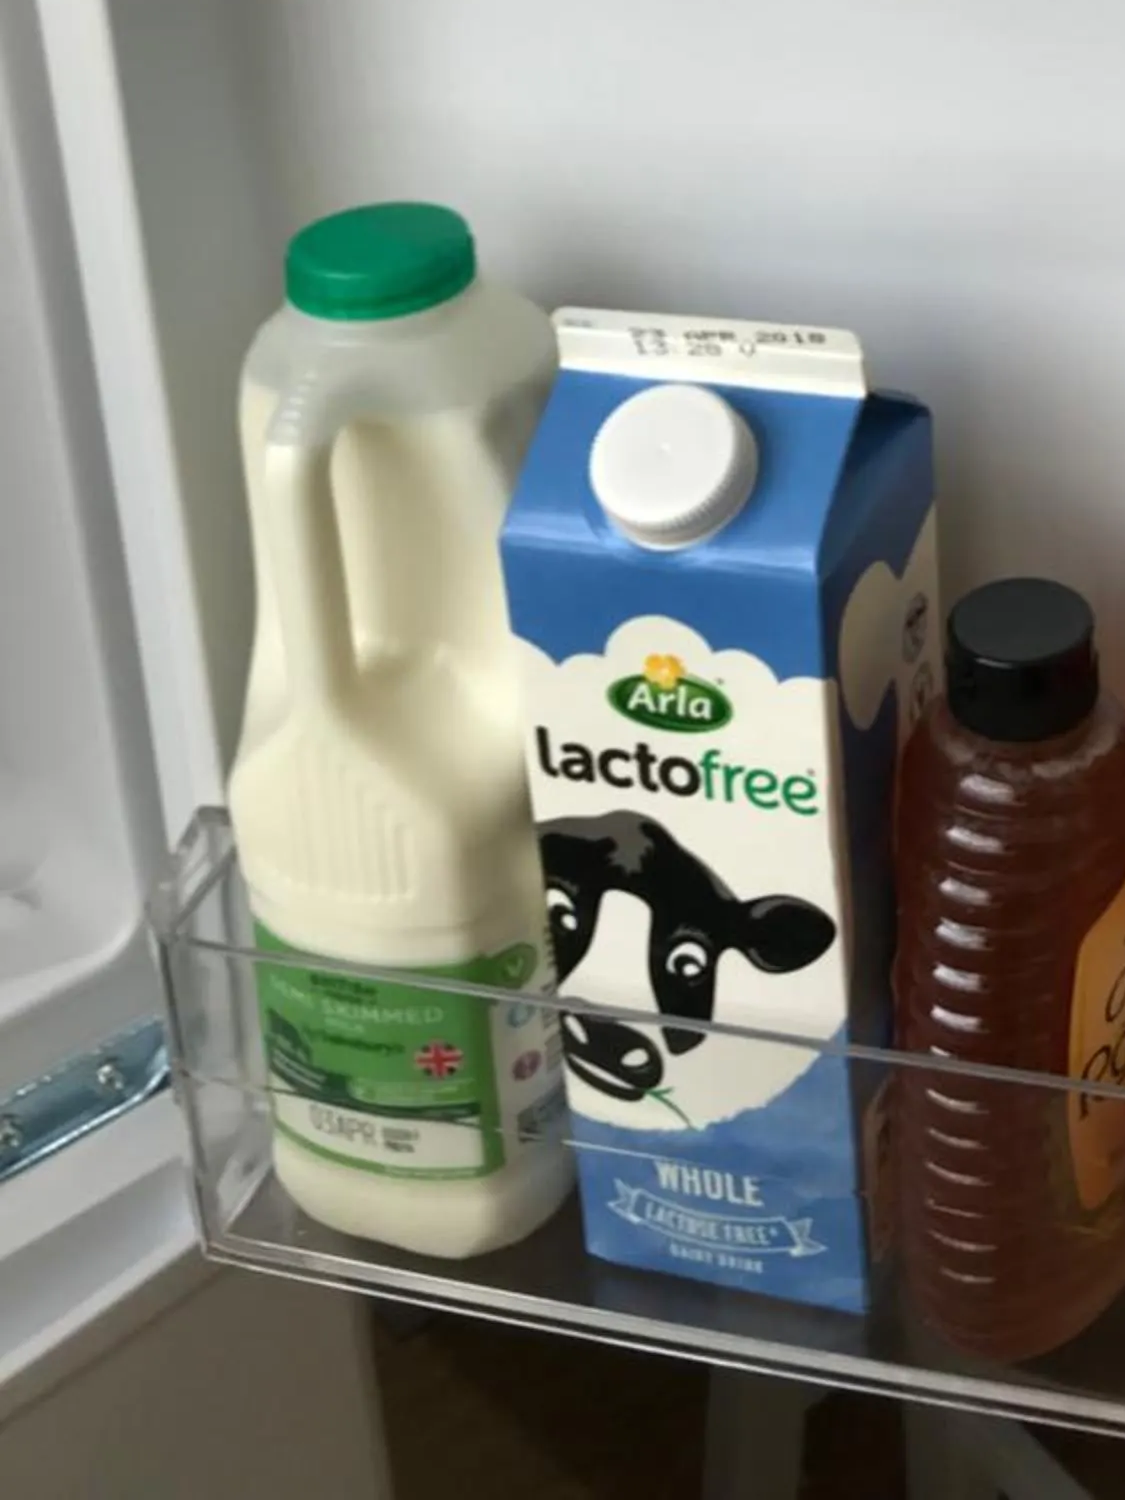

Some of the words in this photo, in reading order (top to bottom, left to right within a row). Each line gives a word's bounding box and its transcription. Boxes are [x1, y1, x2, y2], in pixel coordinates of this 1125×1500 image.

[627, 683, 712, 720] Arla
[535, 725, 819, 816] lactofree
[653, 1159, 765, 1209] WHOLE
